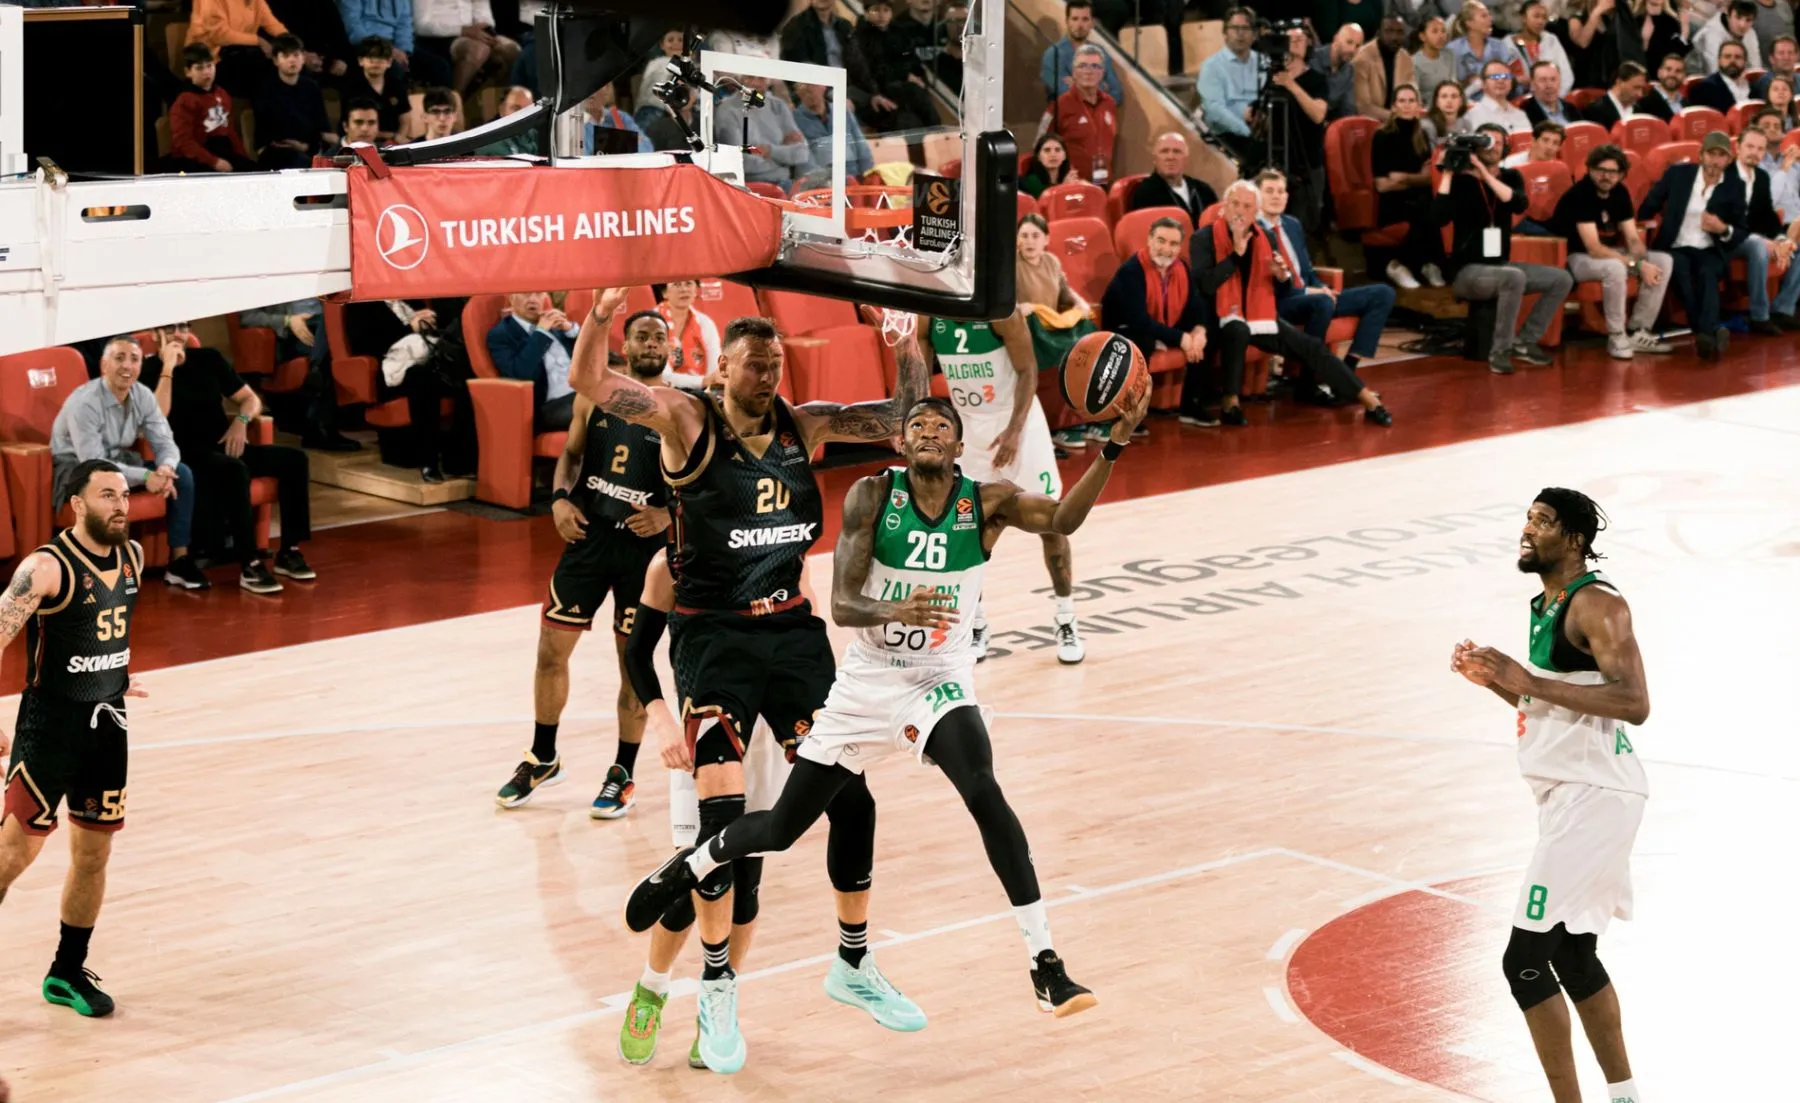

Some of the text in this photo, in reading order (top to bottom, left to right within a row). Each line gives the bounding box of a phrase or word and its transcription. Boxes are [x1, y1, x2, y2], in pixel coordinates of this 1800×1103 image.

[440, 206, 696, 248] TURKISH AIRLINES
[921, 215, 956, 229] TURKISH
[954, 328, 969, 353] 2
[611, 444, 629, 474] 2
[756, 477, 790, 514] 20
[1039, 471, 1055, 495] 2
[727, 522, 817, 549] SKWEEK
[904, 530, 948, 570] 26
[96, 605, 127, 641] 55
[1526, 884, 1548, 921] 8
